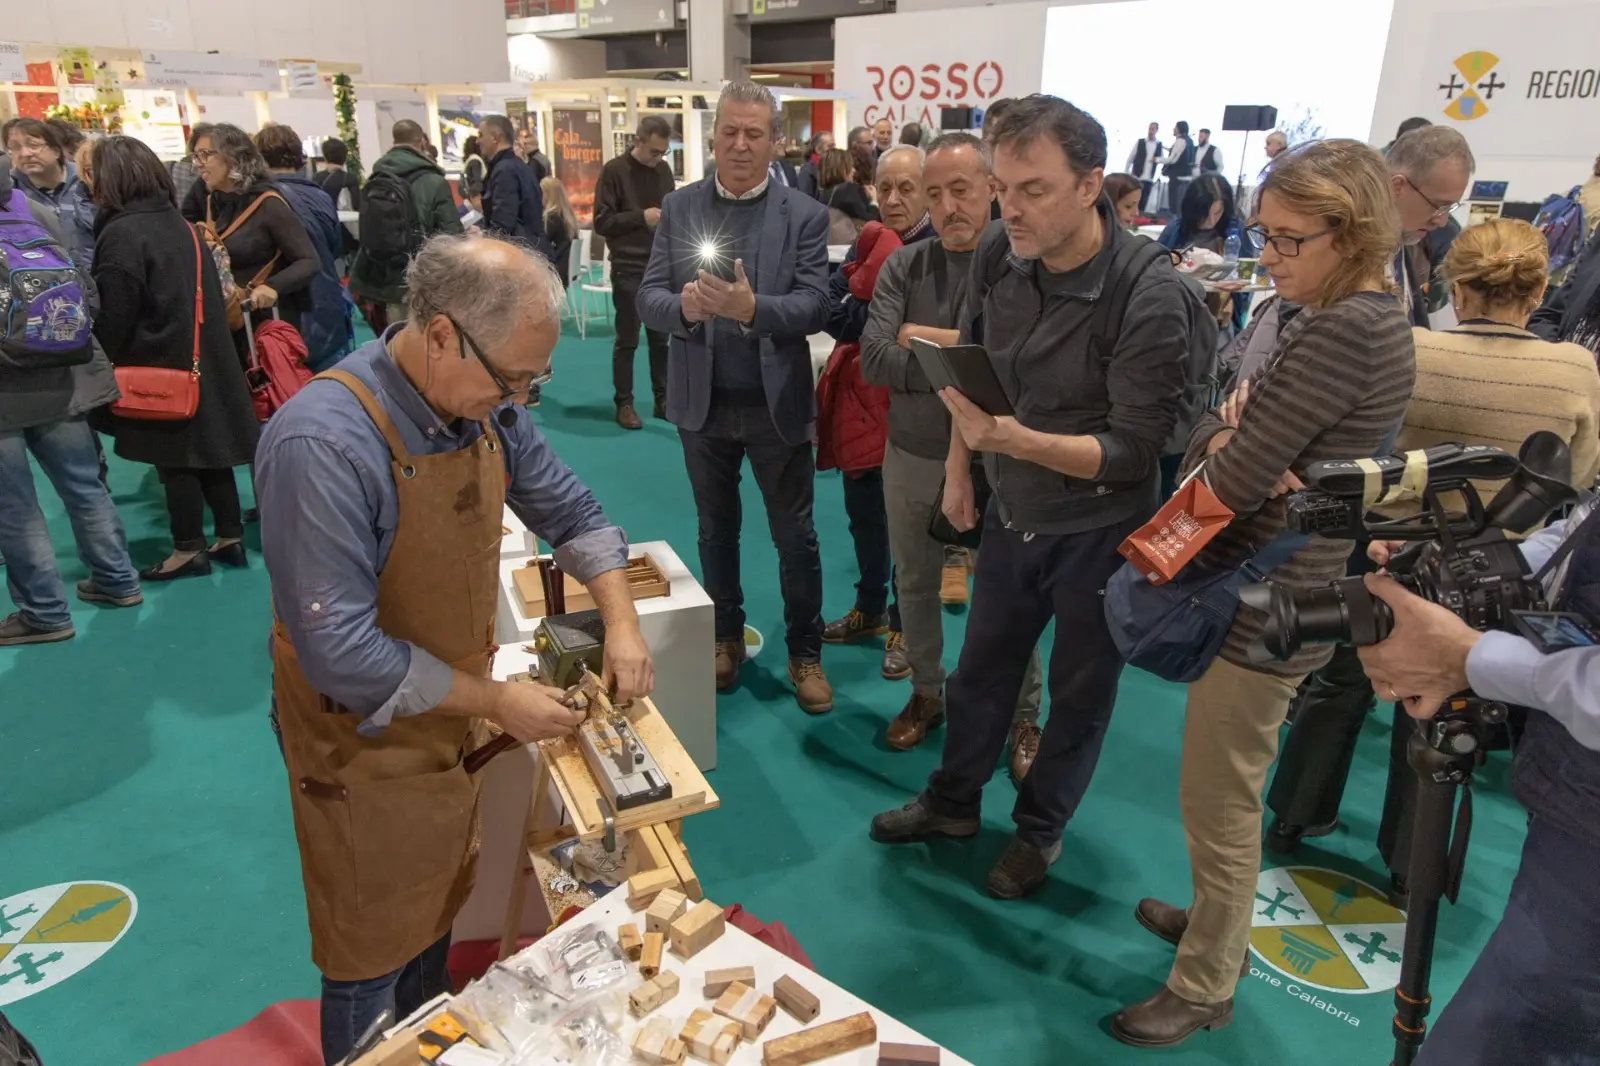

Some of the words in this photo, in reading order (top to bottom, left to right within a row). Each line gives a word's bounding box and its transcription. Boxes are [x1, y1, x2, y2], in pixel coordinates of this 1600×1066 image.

[866, 61, 1003, 100] ROSSO
[1527, 69, 1600, 99] REGIO
[563, 144, 601, 164] burger
[1323, 458, 1390, 469] Can
[1287, 984, 1361, 1027] Calabria
